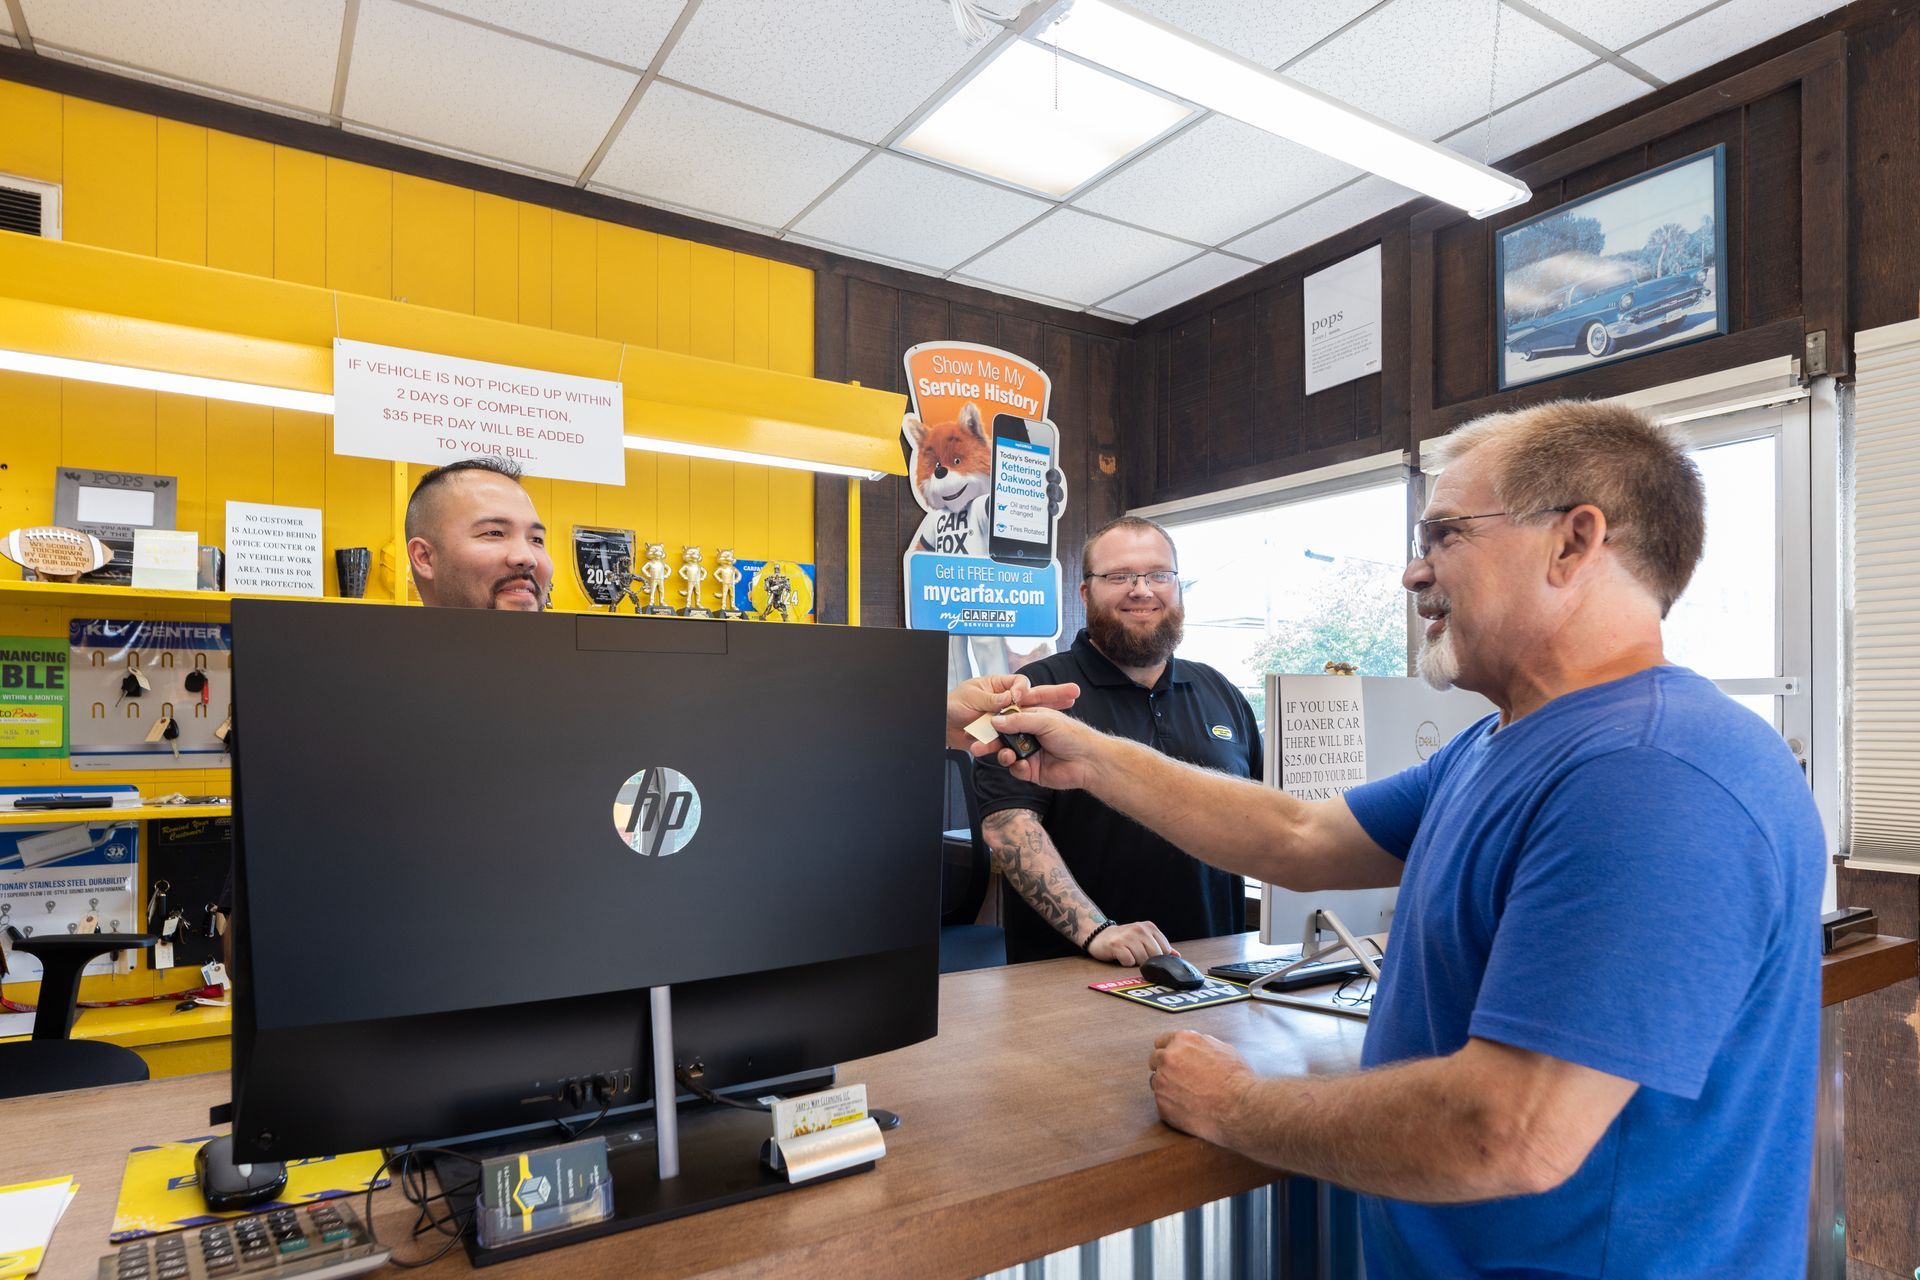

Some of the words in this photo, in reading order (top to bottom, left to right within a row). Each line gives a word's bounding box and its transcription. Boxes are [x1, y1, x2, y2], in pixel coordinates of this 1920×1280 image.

[1312, 311, 1343, 334] pops
[932, 355, 973, 375] Show
[978, 360, 1000, 380] Me
[1004, 366, 1025, 390] My
[348, 358, 362, 370] IF
[366, 360, 432, 381] VEHICLE
[436, 372, 450, 384] IS
[454, 375, 485, 389] NOT
[488, 380, 540, 397] PICKED
[543, 387, 562, 400] UP
[565, 391, 612, 407] WITHIN
[919, 378, 980, 398] Service
[984, 382, 1039, 416] History
[397, 388, 405, 399] 2
[410, 390, 449, 405] DAYS
[453, 396, 473, 408] OF
[477, 399, 571, 424] COMPLETION,
[383, 407, 410, 422] $35
[413, 412, 443, 427] PER
[448, 417, 476, 431] DAY
[480, 421, 513, 436] WILL
[517, 426, 534, 439] BE
[537, 429, 585, 445] ADDED
[437, 437, 457, 450] TO
[460, 440, 501, 455] YOUR
[506, 446, 538, 460] BILL.
[1000, 451, 1022, 462] Today's
[1024, 456, 1047, 466] Service
[1002, 461, 1041, 478] Kettering
[92, 472, 144, 487] POPS
[1000, 472, 1042, 487] Oakwood
[996, 483, 1045, 499] Automotive
[245, 514, 258, 522] NO
[259, 515, 304, 526] CUSTOMER
[1010, 509, 1033, 518] changed
[937, 510, 968, 534] CAR
[75, 528, 106, 536] MPLY
[242, 527, 284, 537] ALLOWED
[286, 531, 317, 540] BEHIND
[1010, 525, 1023, 533] Tires
[1024, 527, 1045, 536] Rotated
[46, 542, 76, 551] SCORED
[232, 539, 261, 548] OFFICE
[263, 542, 302, 551] COUNTER
[304, 544, 316, 552] OR
[936, 533, 969, 554] FOX
[32, 548, 83, 556] TOUCHDOWN
[236, 552, 246, 560] IN
[249, 553, 284, 562] VEHICLE
[287, 555, 312, 564] WORK
[60, 560, 86, 568] DADDY
[237, 565, 262, 574] AREA.
[265, 567, 284, 575] THIS
[296, 569, 312, 577] FOR
[935, 564, 954, 579] Get
[958, 566, 965, 580] it
[967, 566, 995, 581] FREE
[998, 571, 1020, 582] now
[1022, 570, 1033, 583] at
[234, 578, 258, 586] YOUR
[260, 579, 315, 589] PROTECTION.
[923, 583, 1045, 606] mycarfax.com
[139, 625, 221, 639] CENTER
[0, 650, 66, 663] NANCING
[2, 664, 64, 689] BLE
[1286, 702, 1297, 713] IF
[1299, 701, 1325, 713] YOU
[1328, 700, 1349, 712] USE
[1351, 700, 1359, 711] A
[1287, 718, 1335, 731] LOANER
[1337, 717, 1360, 729] CAR
[1284, 736, 1316, 749] THERE
[1318, 735, 1342, 747] WILL
[1343, 734, 1355, 746] BE
[1357, 734, 1363, 745] A
[1419, 736, 1438, 747] DELL
[1284, 753, 1317, 767] $25.00
[1319, 751, 1364, 765] CHARGE
[1284, 771, 1312, 784] ADDED
[1313, 770, 1323, 783] TO
[1325, 769, 1346, 782] YOUR
[1347, 768, 1365, 780] BILL.
[1289, 787, 1331, 801] THANK
[1334, 786, 1353, 797] YO
[625, 767, 693, 857] hp
[29, 880, 66, 889] STAINLESS
[67, 879, 87, 887] STEEL
[89, 877, 127, 886] DURABILITY
[1157, 984, 1241, 1005] Auto
